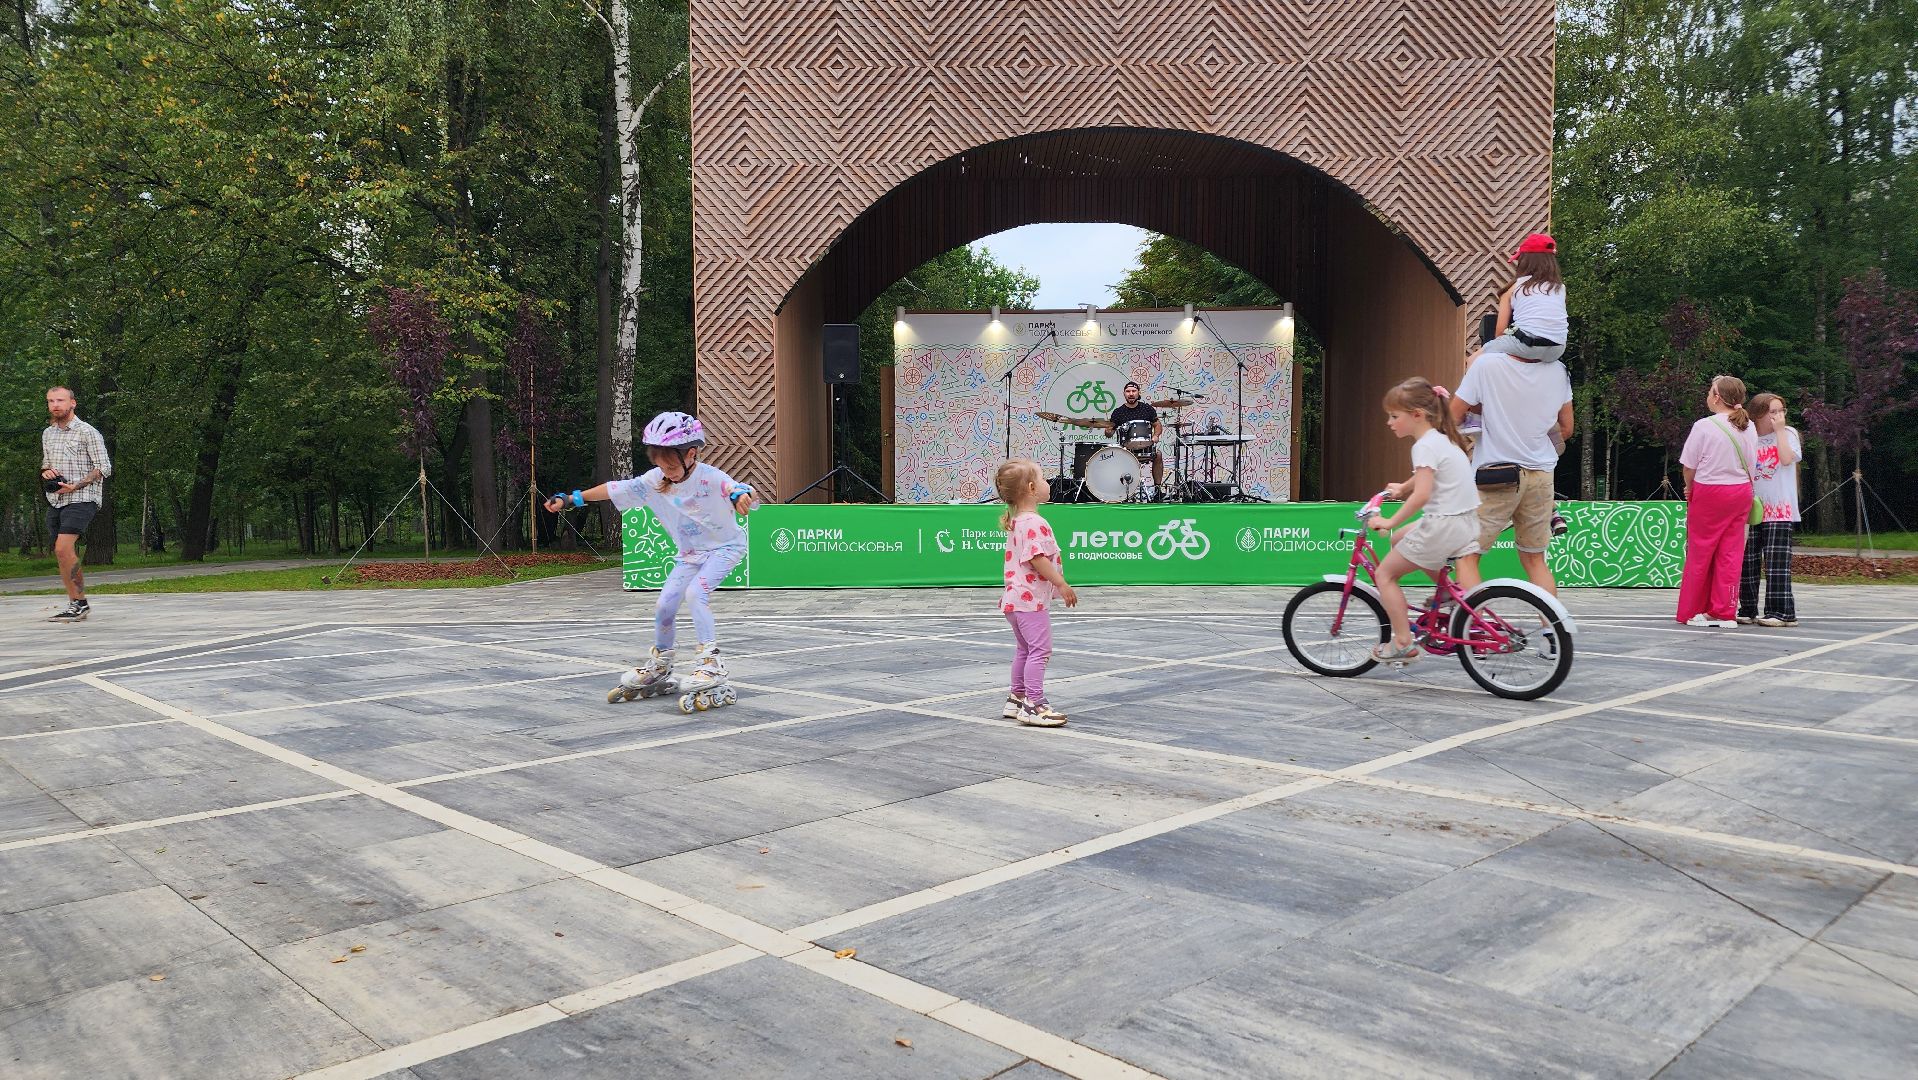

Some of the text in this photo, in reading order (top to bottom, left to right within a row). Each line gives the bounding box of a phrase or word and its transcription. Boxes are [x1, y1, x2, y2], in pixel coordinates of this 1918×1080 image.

[797, 529, 842, 540] ПАРКИ
[961, 528, 1009, 539] Парк име
[1263, 527, 1310, 539] ПАРКИ
[962, 540, 974, 550] Н.
[1263, 540, 1373, 552] ПОДМОСКОВЯ
[1077, 552, 1143, 560] ПОДМОСКОВЬЕ
